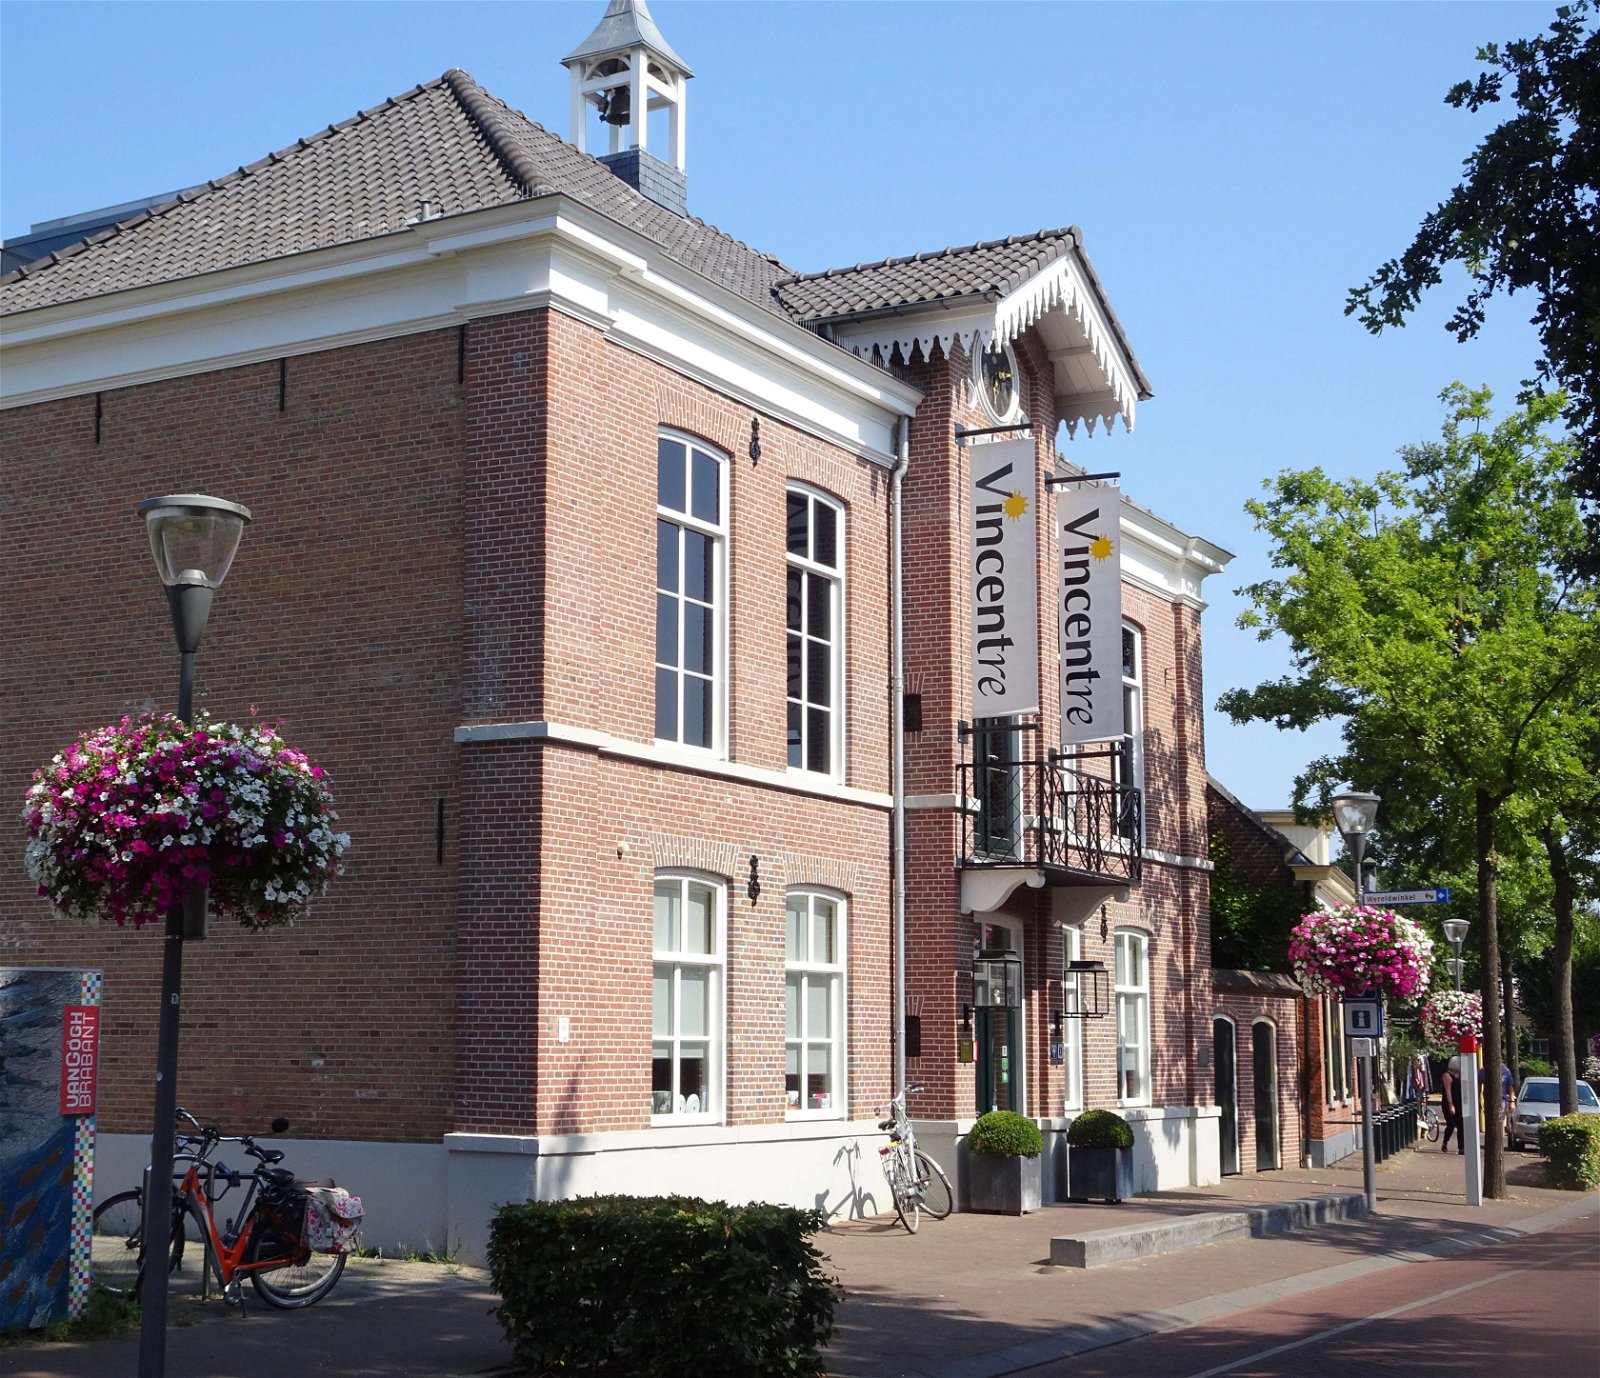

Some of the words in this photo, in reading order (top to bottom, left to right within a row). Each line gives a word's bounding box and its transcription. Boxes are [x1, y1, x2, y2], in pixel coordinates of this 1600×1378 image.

[975, 462, 1026, 697] Vincentre
[1064, 508, 1111, 726] Vincentre
[1366, 894, 1416, 903] Wereldwinkel
[79, 1012, 95, 1107] BRABANT
